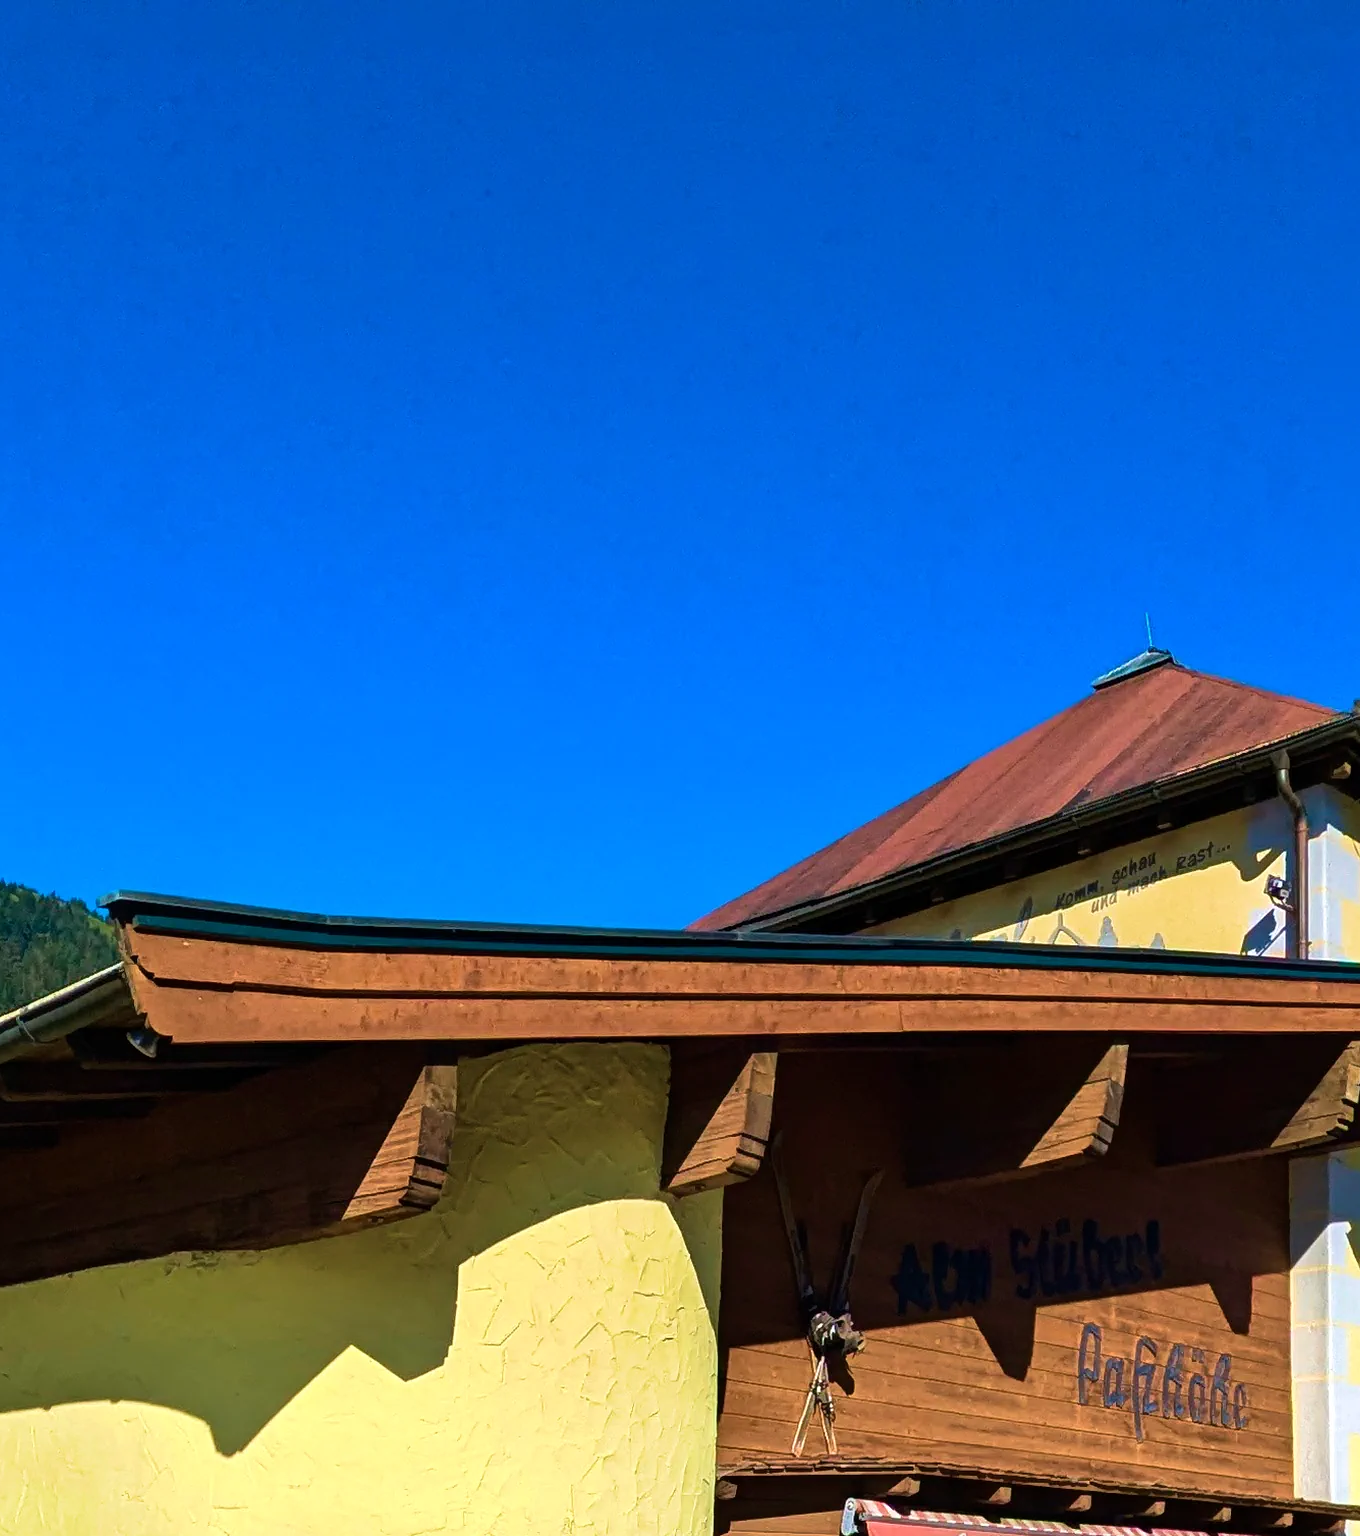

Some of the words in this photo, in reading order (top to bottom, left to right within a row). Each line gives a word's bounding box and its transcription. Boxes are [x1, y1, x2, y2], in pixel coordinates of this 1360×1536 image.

[1111, 852, 1156, 885] schau
[1091, 888, 1118, 913] und
[890, 1242, 992, 1316] Alm
[1009, 1217, 1163, 1299] Stüberl
